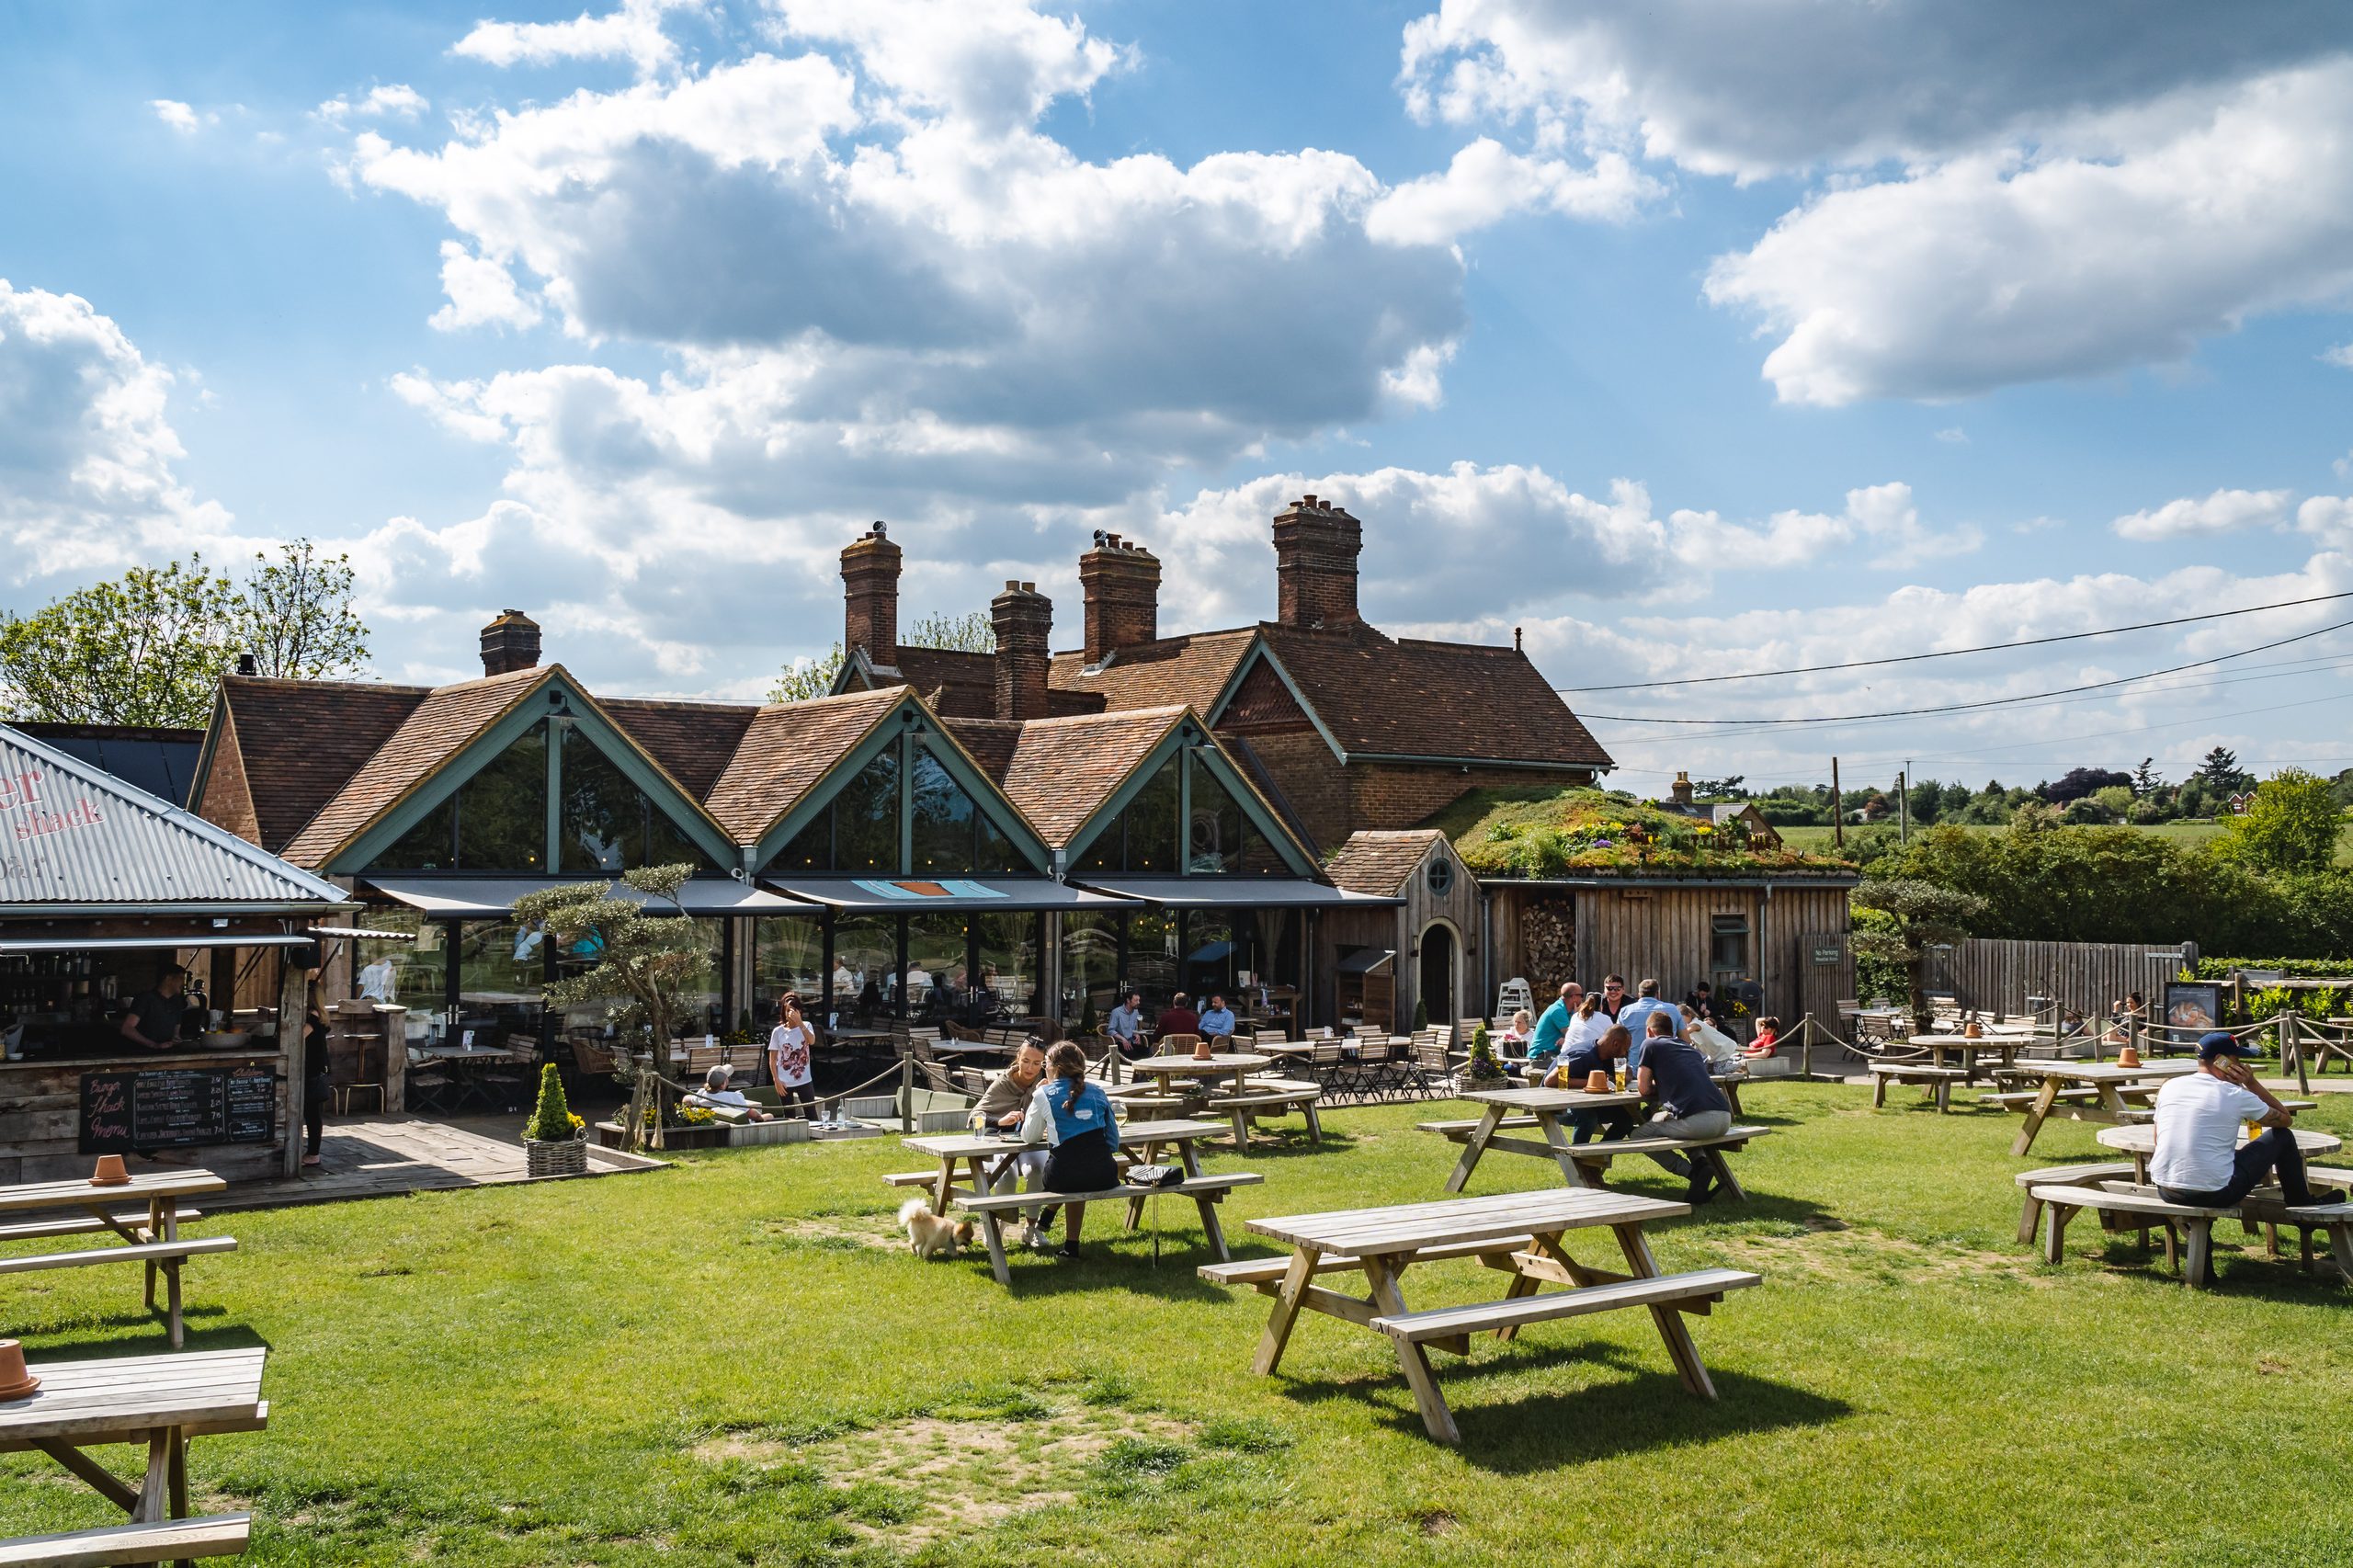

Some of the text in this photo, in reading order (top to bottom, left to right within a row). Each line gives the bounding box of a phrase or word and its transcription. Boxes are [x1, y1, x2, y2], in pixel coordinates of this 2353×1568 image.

[14, 797, 106, 841] shack
[89, 1078, 121, 1096] Burger
[87, 1095, 125, 1118] Shack
